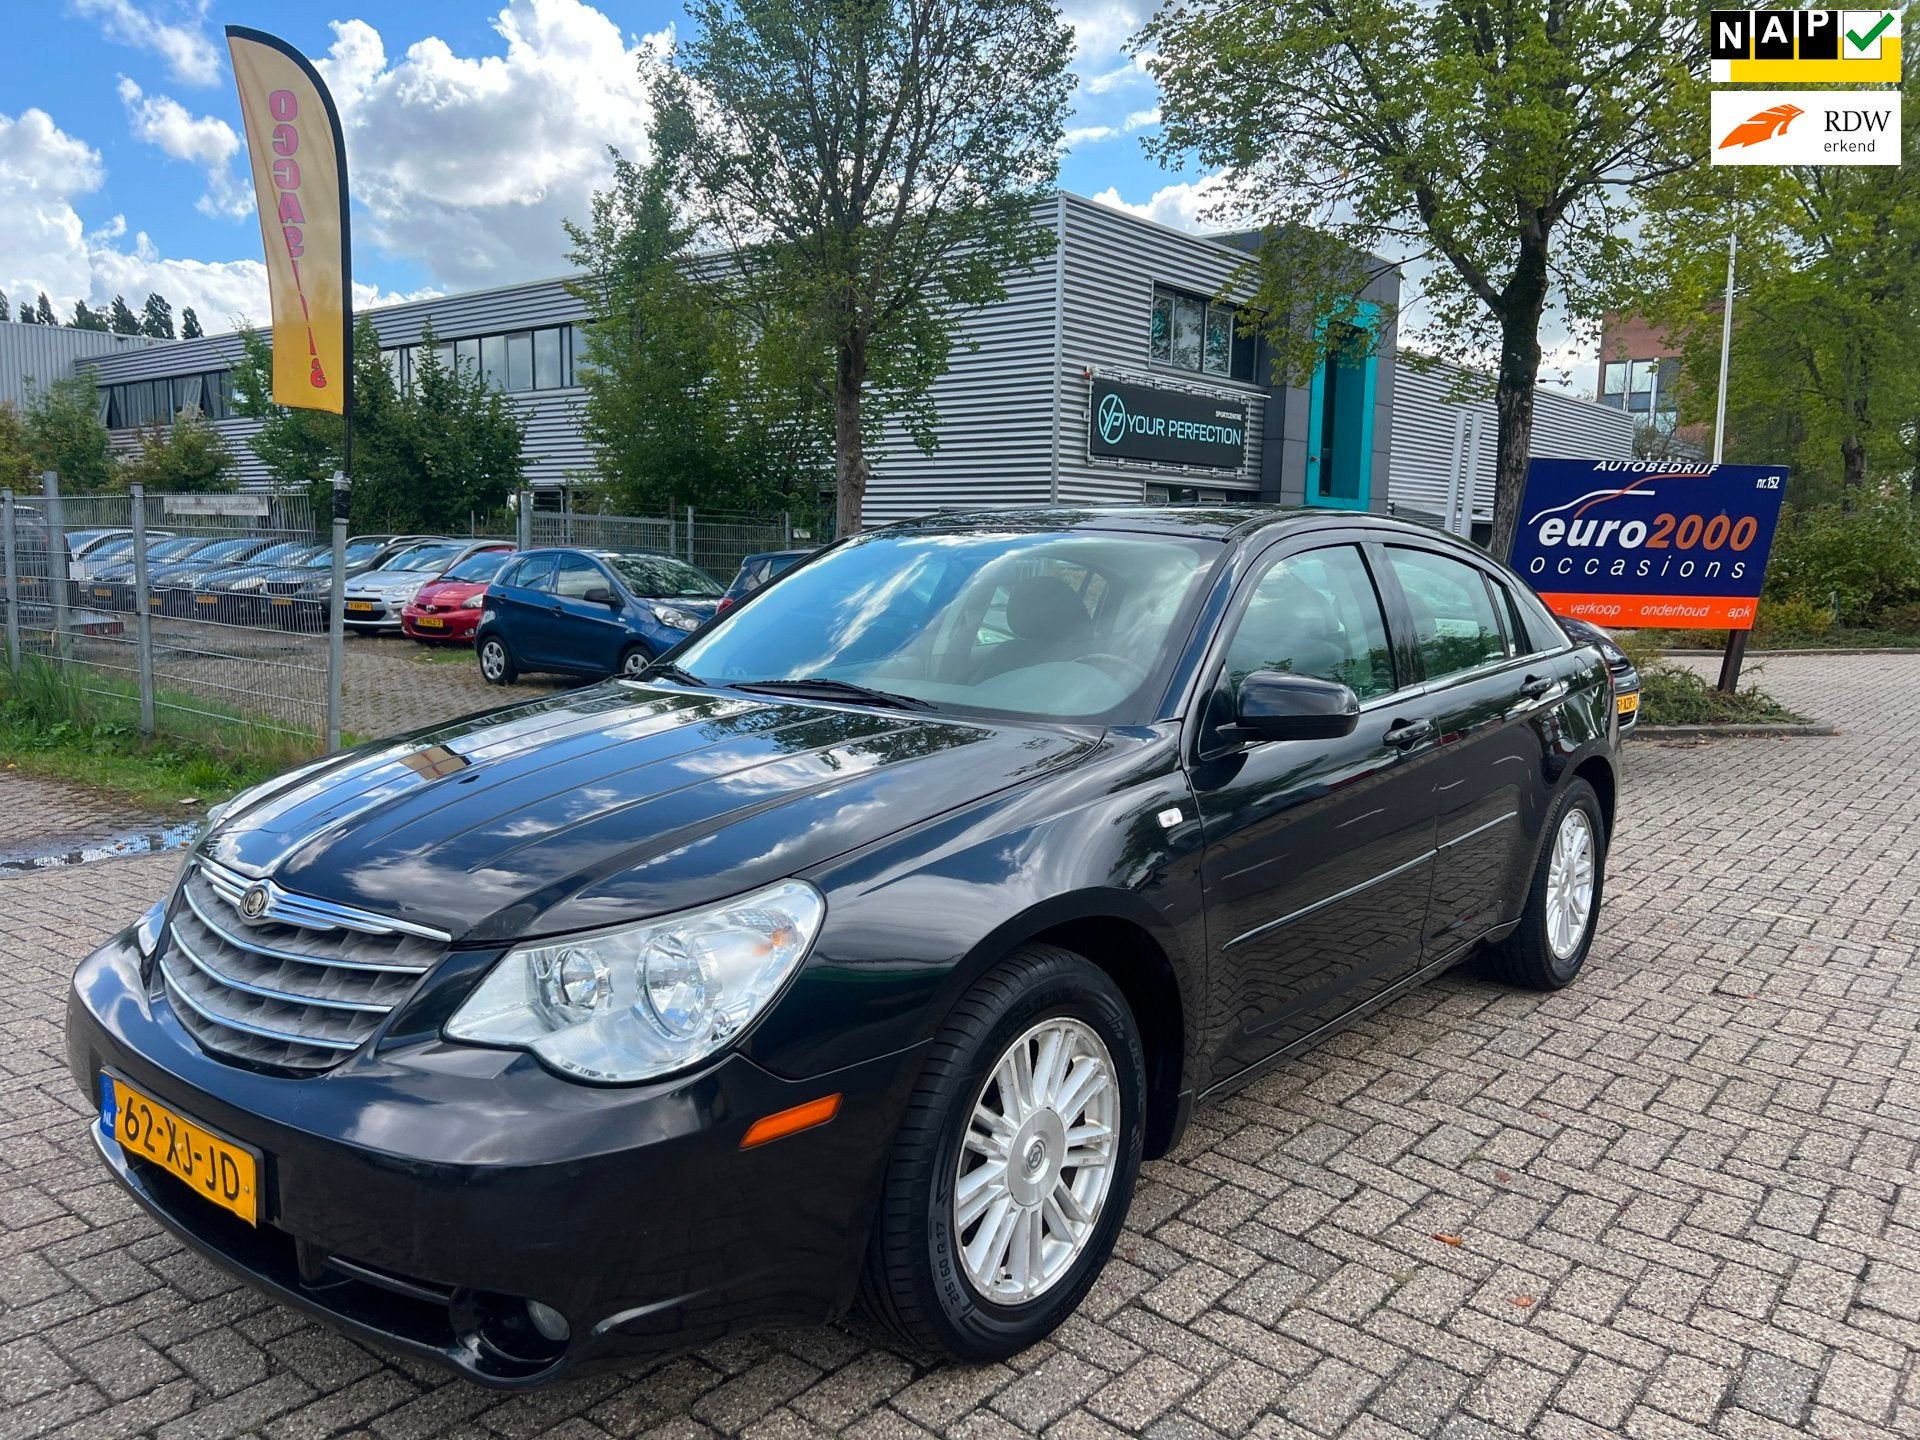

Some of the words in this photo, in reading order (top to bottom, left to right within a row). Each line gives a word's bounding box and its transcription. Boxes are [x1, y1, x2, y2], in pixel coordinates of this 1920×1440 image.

[1126, 414, 1165, 437] YOUR
[1168, 420, 1242, 446] PERFECTION
[1593, 460, 1720, 475] AUTOBEDRIJF
[1538, 513, 1758, 551] euro2000
[1530, 555, 1746, 579] occasions
[1570, 602, 1621, 616] verkoop
[1640, 603, 1710, 617] onderhoud
[1727, 606, 1751, 619] apk
[102, 1109, 114, 1128] NL
[124, 1096, 240, 1201] 62-XJ-JD
